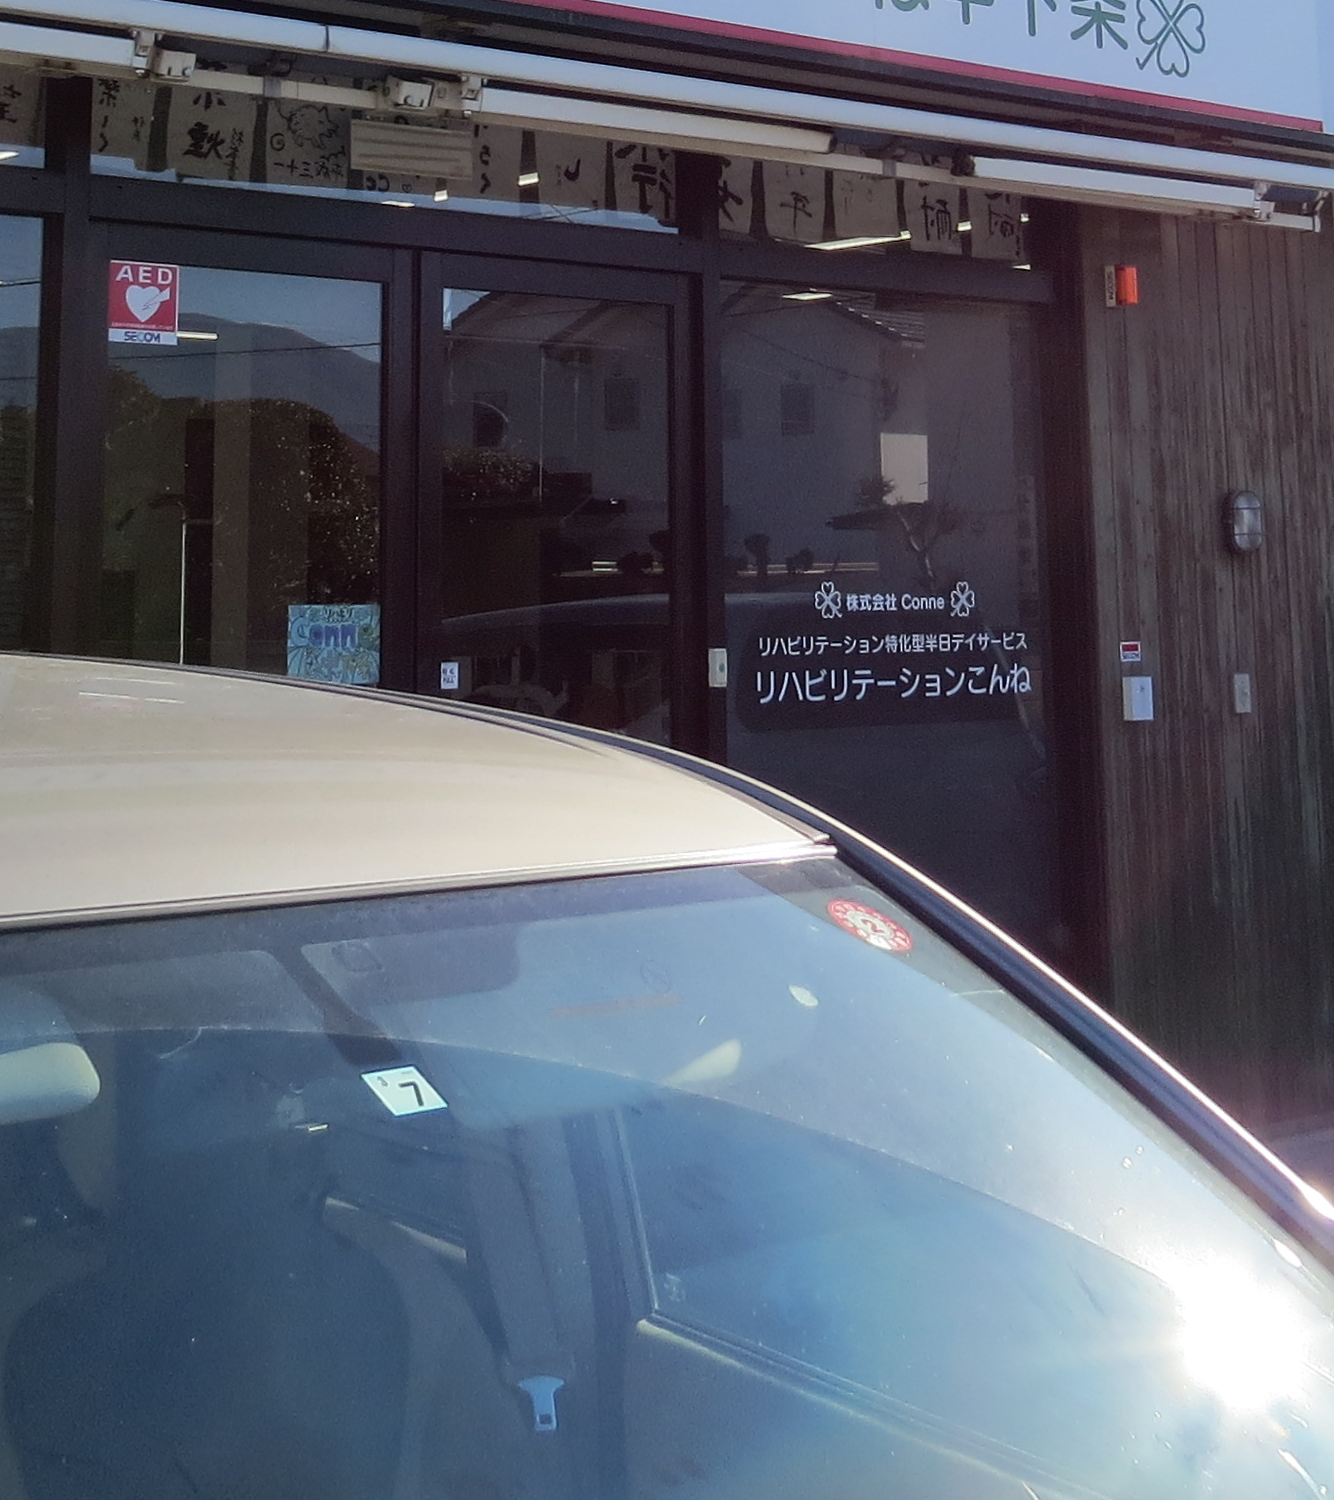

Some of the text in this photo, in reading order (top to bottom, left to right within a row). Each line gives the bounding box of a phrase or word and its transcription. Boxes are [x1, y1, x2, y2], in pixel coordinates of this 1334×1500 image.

[115, 265, 173, 285] AED
[123, 330, 161, 343] SECOM
[846, 593, 945, 612] 株式会社 Conne
[759, 632, 1028, 657] リハビリテーション特化型半日デイサービス
[756, 662, 1033, 704] リハビリテーションこんね
[397, 1081, 424, 1107] 7
